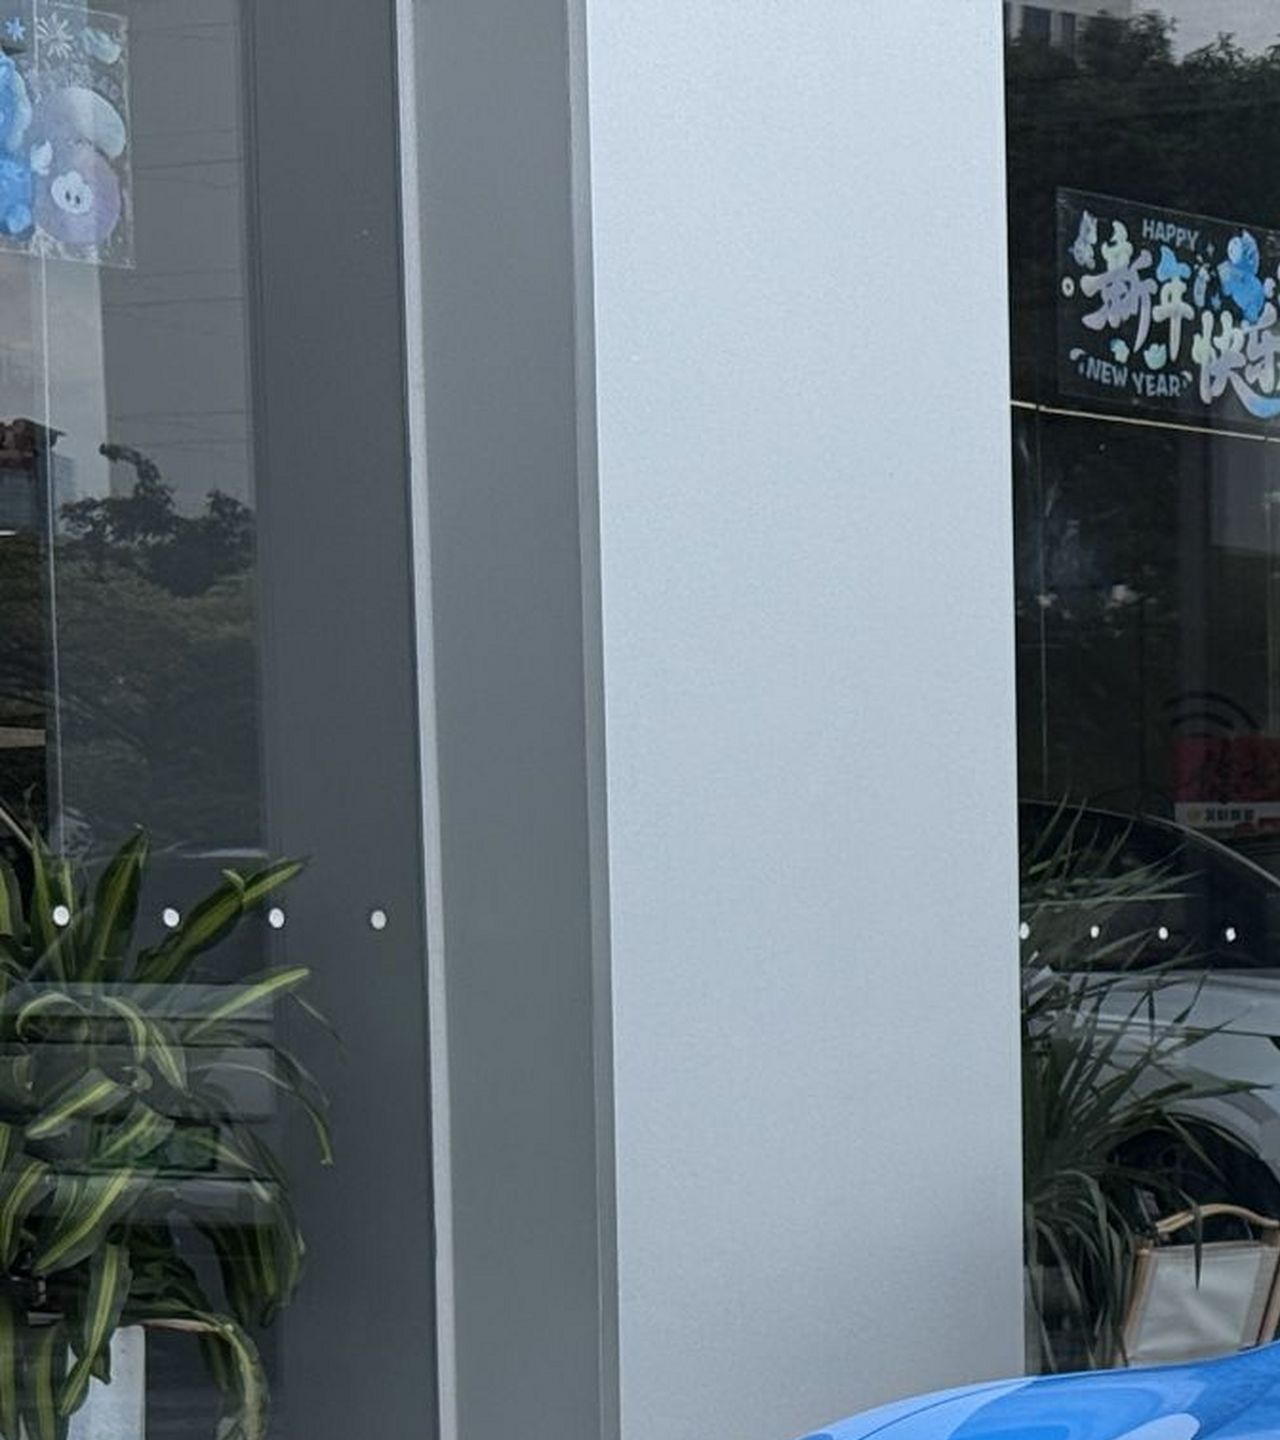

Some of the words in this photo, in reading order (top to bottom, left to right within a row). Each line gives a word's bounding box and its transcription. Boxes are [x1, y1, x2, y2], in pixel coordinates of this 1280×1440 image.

[1142, 219, 1199, 250] HAPPY
[1085, 361, 1128, 387] NEW
[1132, 371, 1181, 397] YEAR
